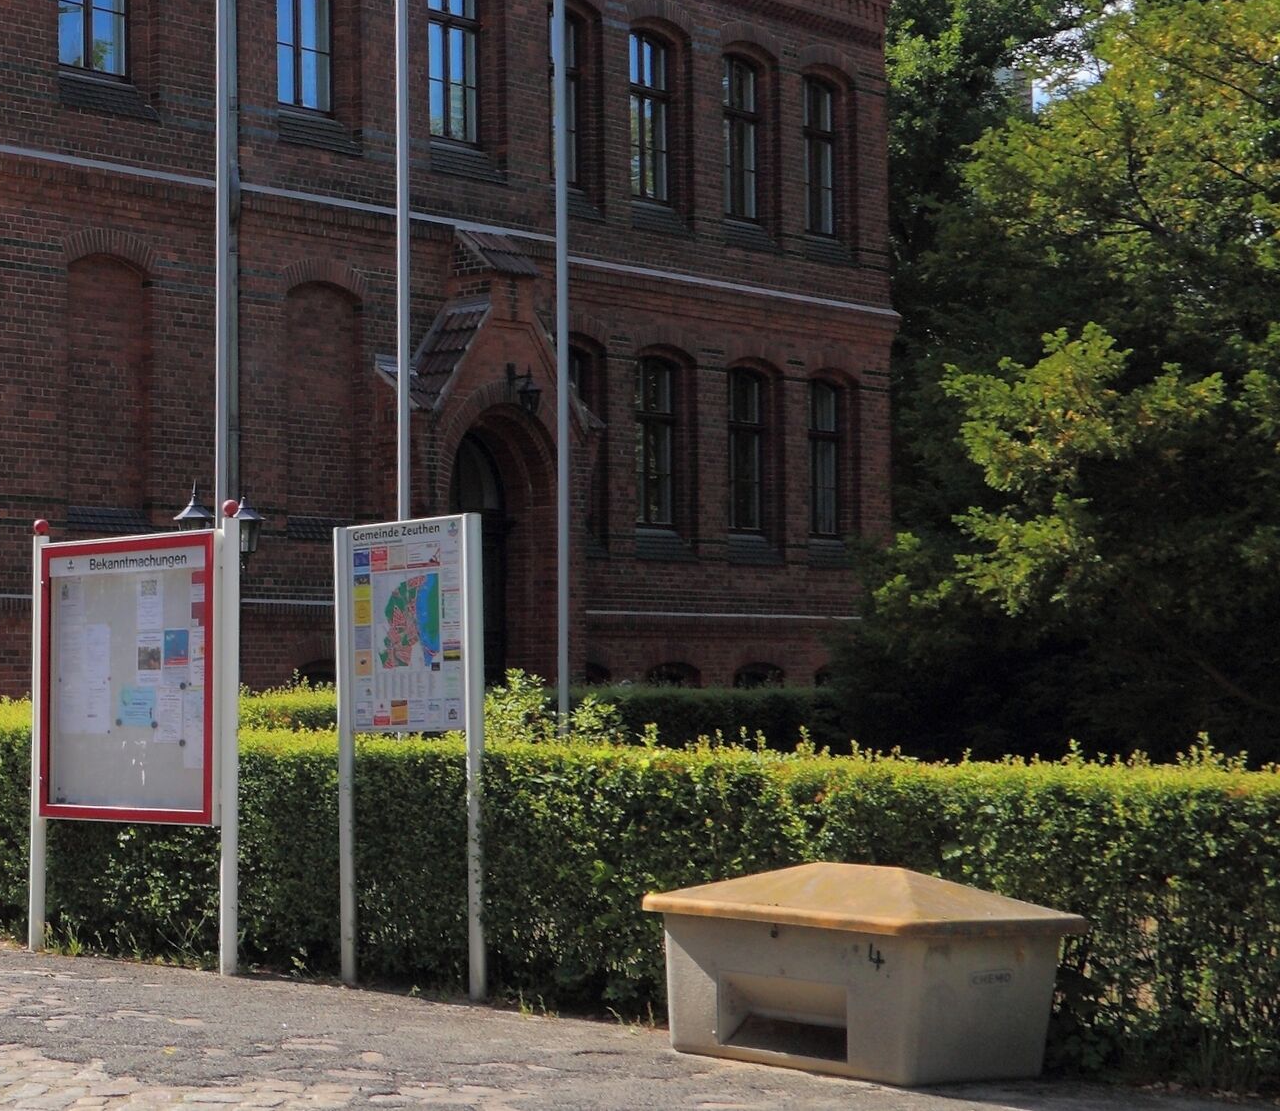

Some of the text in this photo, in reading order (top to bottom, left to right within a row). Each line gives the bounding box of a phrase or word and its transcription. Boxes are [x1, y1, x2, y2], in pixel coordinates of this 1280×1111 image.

[352, 523, 440, 541] Gemeinde Zeuthen
[89, 553, 187, 570] Bekanntmachungen
[868, 943, 886, 971] 4
